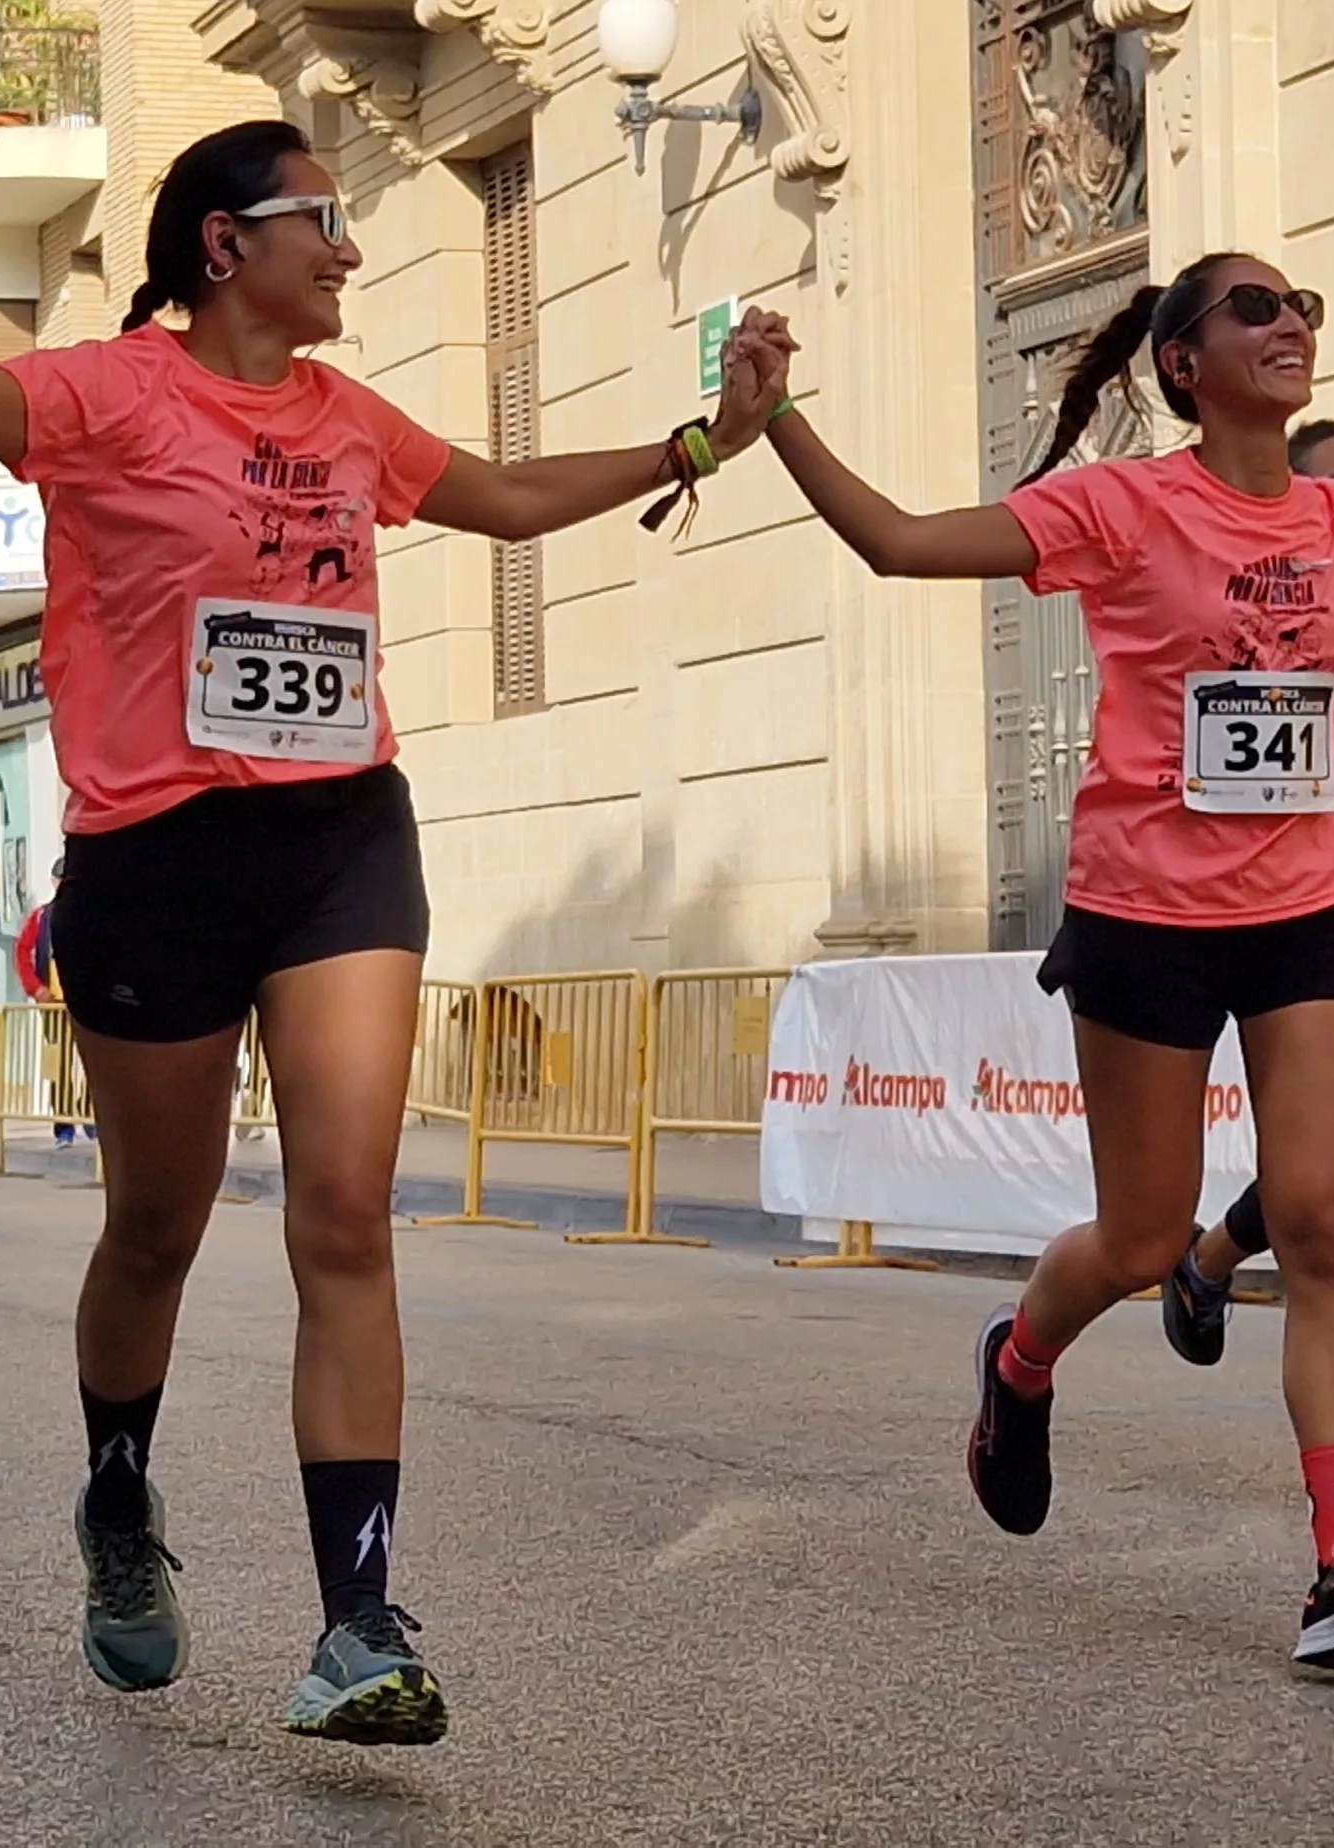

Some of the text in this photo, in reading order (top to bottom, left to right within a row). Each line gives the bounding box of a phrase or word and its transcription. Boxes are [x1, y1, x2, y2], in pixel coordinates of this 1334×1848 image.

[271, 461, 288, 488] LA
[1225, 574, 1254, 601] POR
[1254, 576, 1269, 602] LA
[217, 631, 360, 656] CONTRA EL CÁNCER
[231, 656, 343, 717] 339
[1208, 699, 1271, 713] CONTRA
[1224, 721, 1314, 772] 341
[841, 1055, 947, 1118] Alcampo
[971, 1057, 1086, 1125] Alcampo
